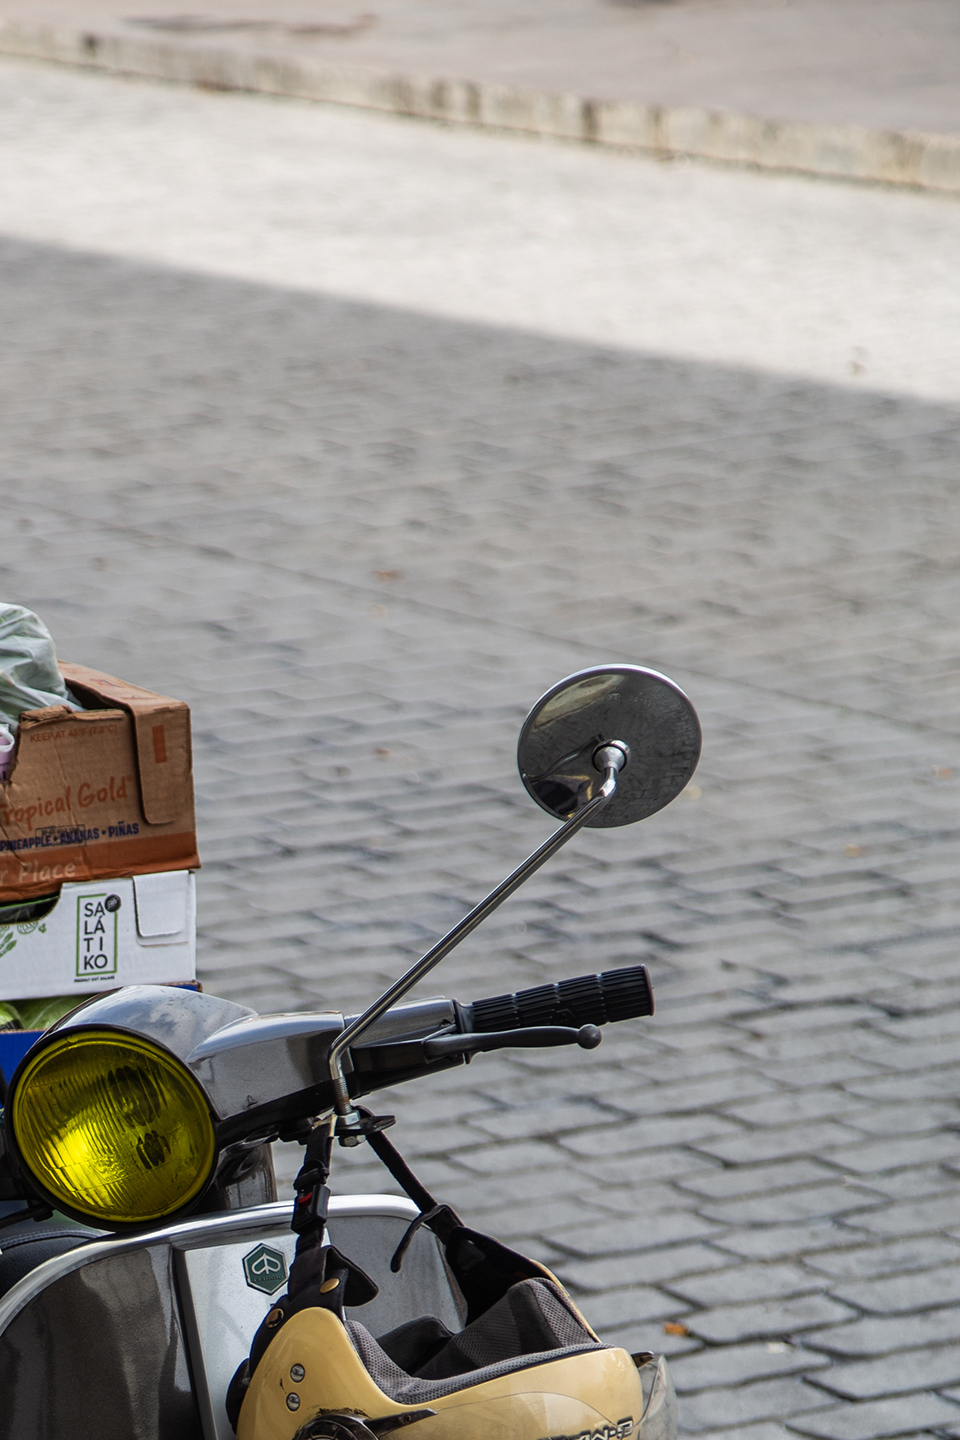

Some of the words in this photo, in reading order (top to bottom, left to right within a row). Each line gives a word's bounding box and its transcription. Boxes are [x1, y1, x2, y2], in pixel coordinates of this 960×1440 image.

[30, 731, 53, 743] KEEP
[55, 729, 66, 740] AT
[77, 775, 129, 809] Gold
[0, 834, 52, 852] PINEAPPLE
[60, 828, 100, 845] ANANAS
[108, 820, 140, 838] PIÑAS
[18, 858, 77, 885] Place
[84, 902, 106, 918] SA
[84, 915, 106, 936] LÁ
[84, 953, 108, 971] KO
